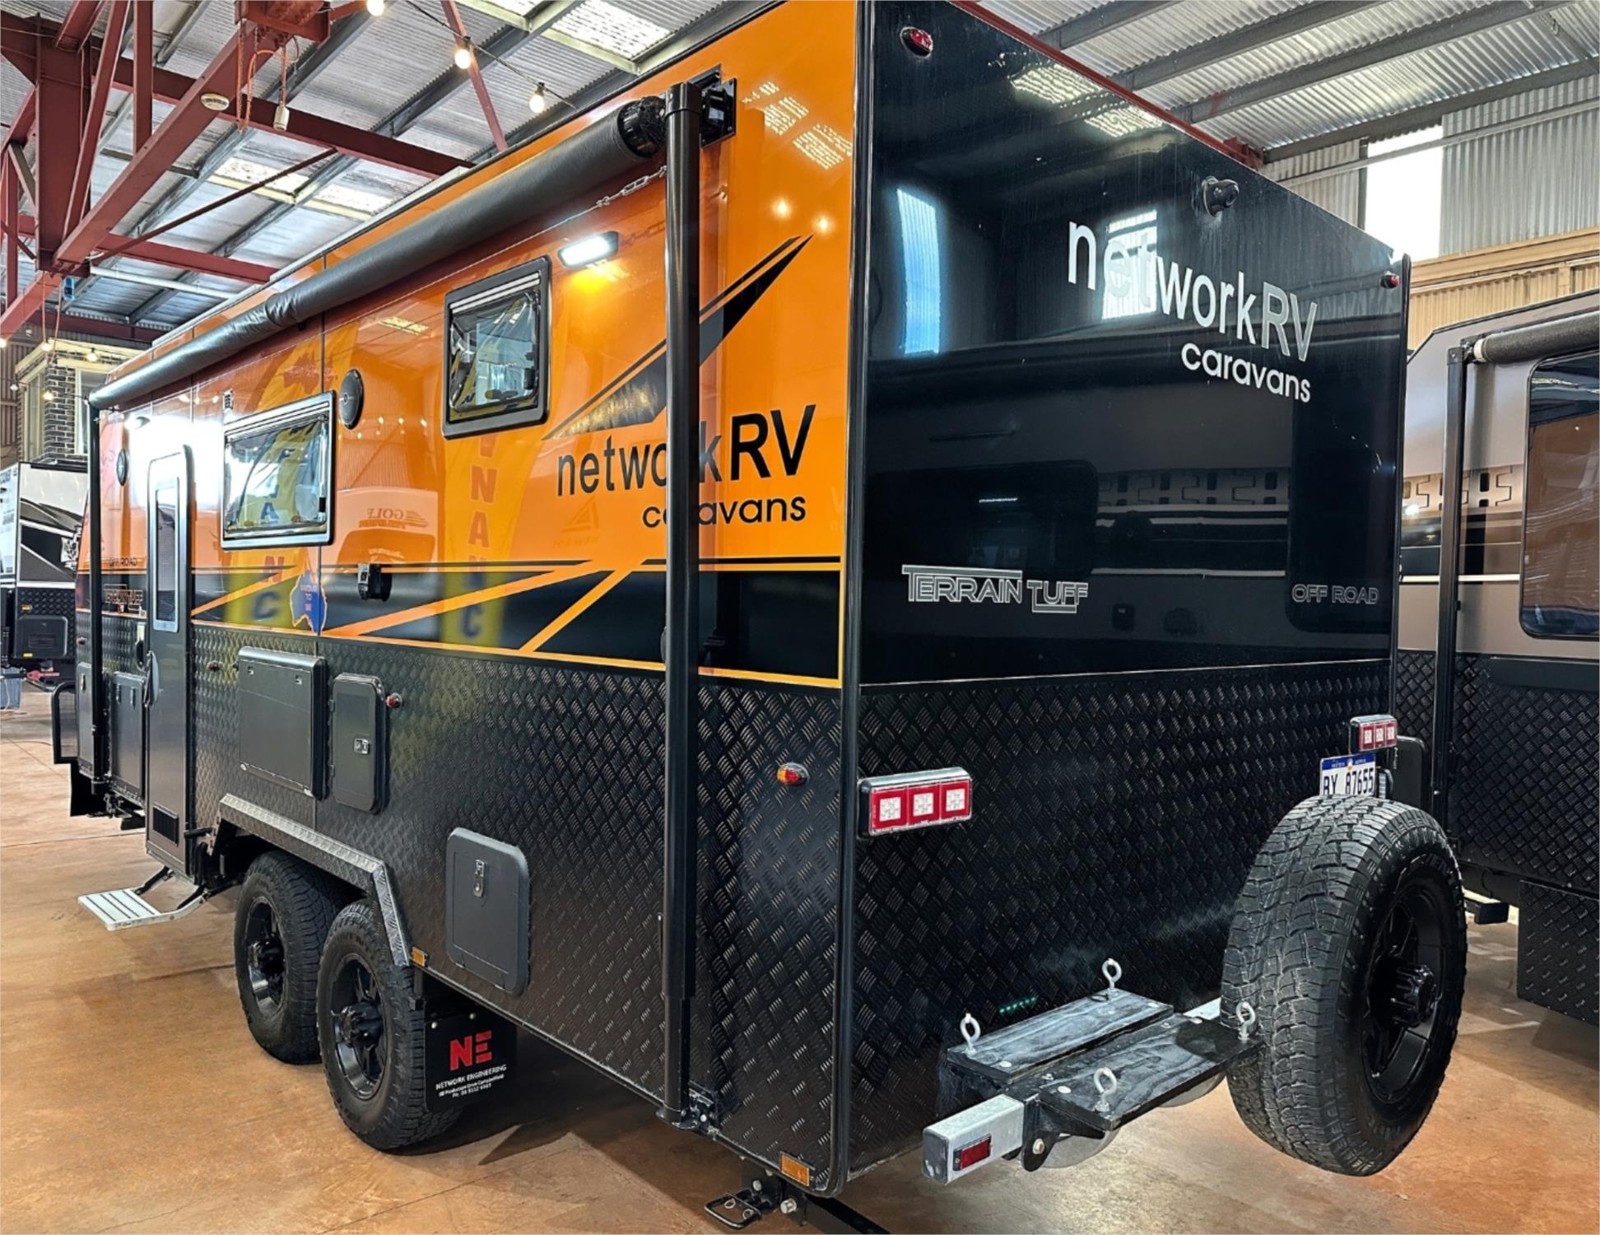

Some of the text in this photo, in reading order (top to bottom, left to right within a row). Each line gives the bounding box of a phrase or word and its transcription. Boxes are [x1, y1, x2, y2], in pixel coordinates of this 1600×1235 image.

[1181, 342, 1311, 403] caravans
[557, 404, 816, 496] netwokRV
[643, 496, 806, 528] cavans
[903, 564, 1089, 613] TERRAIN TUFF
[1292, 584, 1379, 604] OFF ROAD
[450, 1030, 492, 1071] NE
[435, 1064, 507, 1090] NETWORK ENGINEERING
